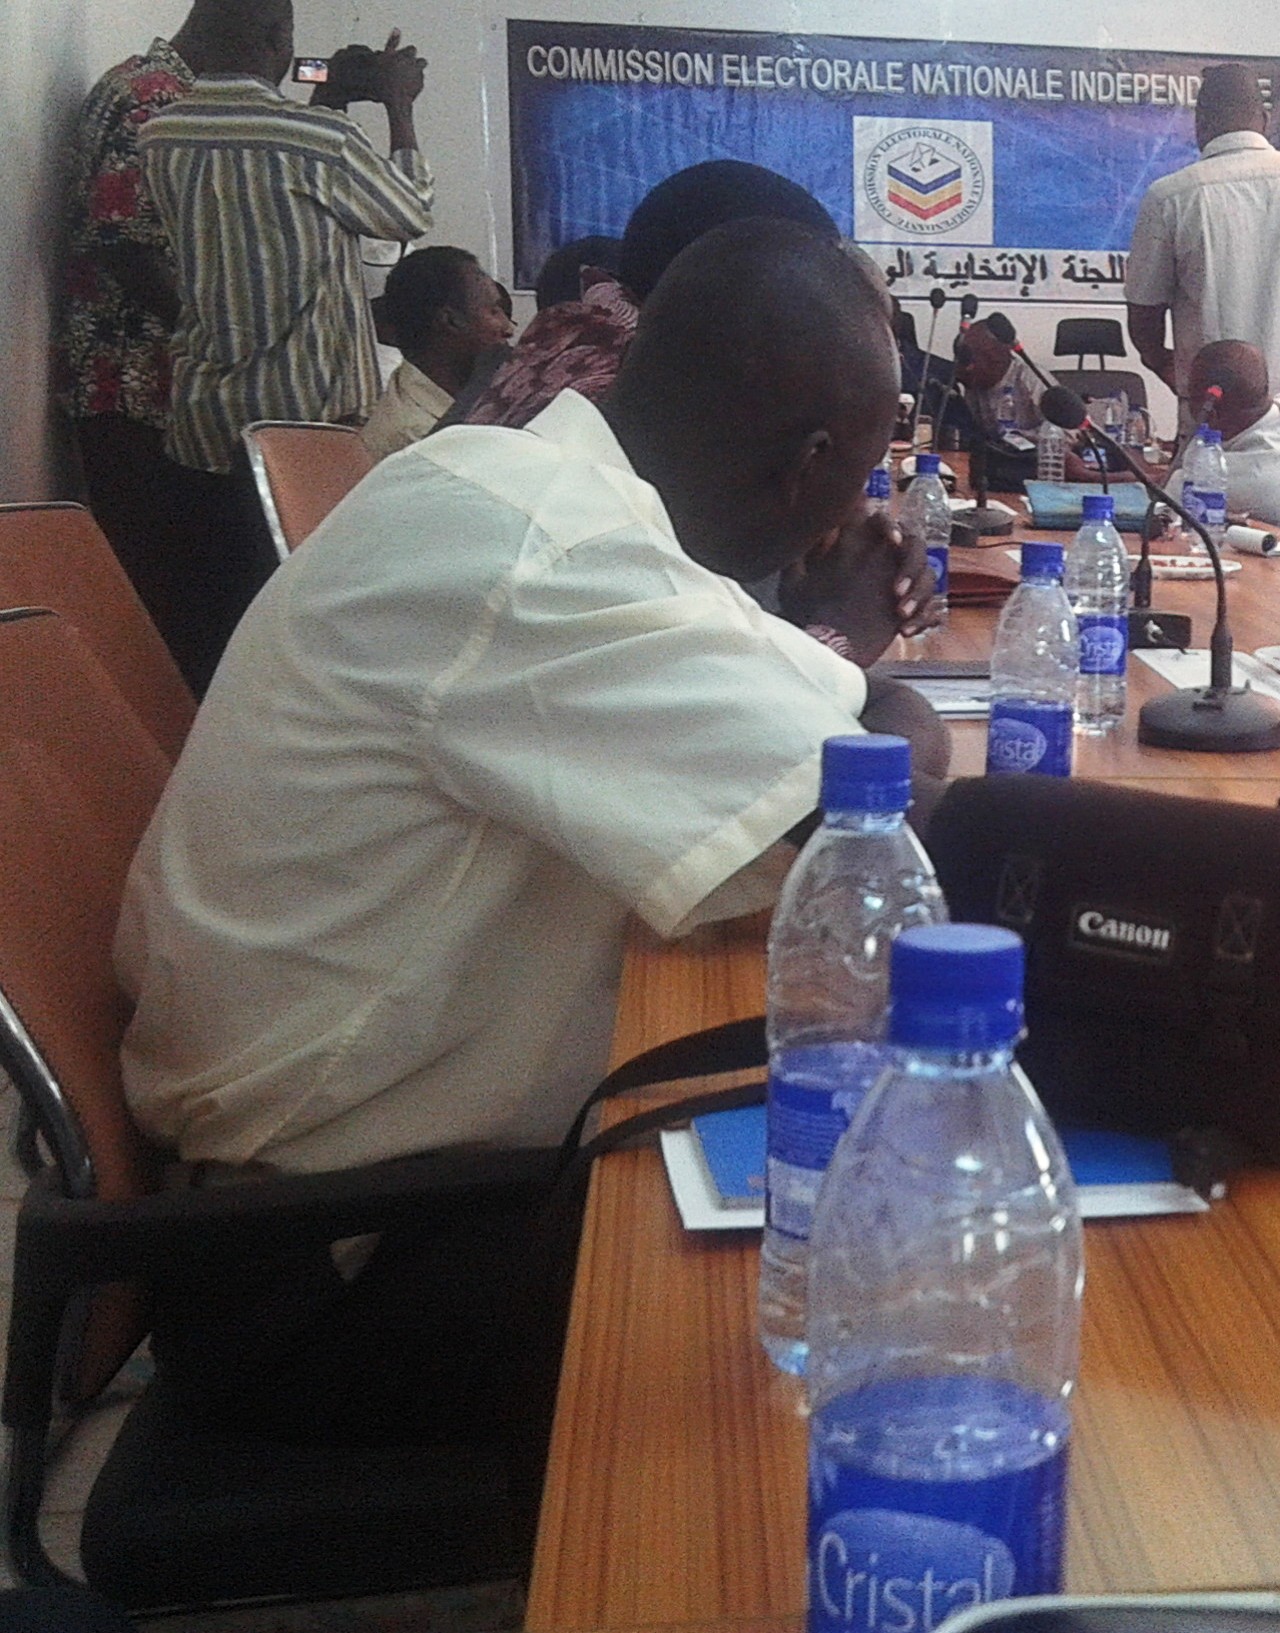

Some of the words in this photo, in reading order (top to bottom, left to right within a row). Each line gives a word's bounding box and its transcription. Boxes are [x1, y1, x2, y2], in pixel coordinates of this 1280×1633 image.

[526, 45, 716, 86] COMMISSION
[722, 53, 905, 93] ELECTORALE
[911, 63, 1065, 101] NATIONALE
[1061, 252, 1126, 290] للجنة
[1078, 910, 1170, 950] Canon
